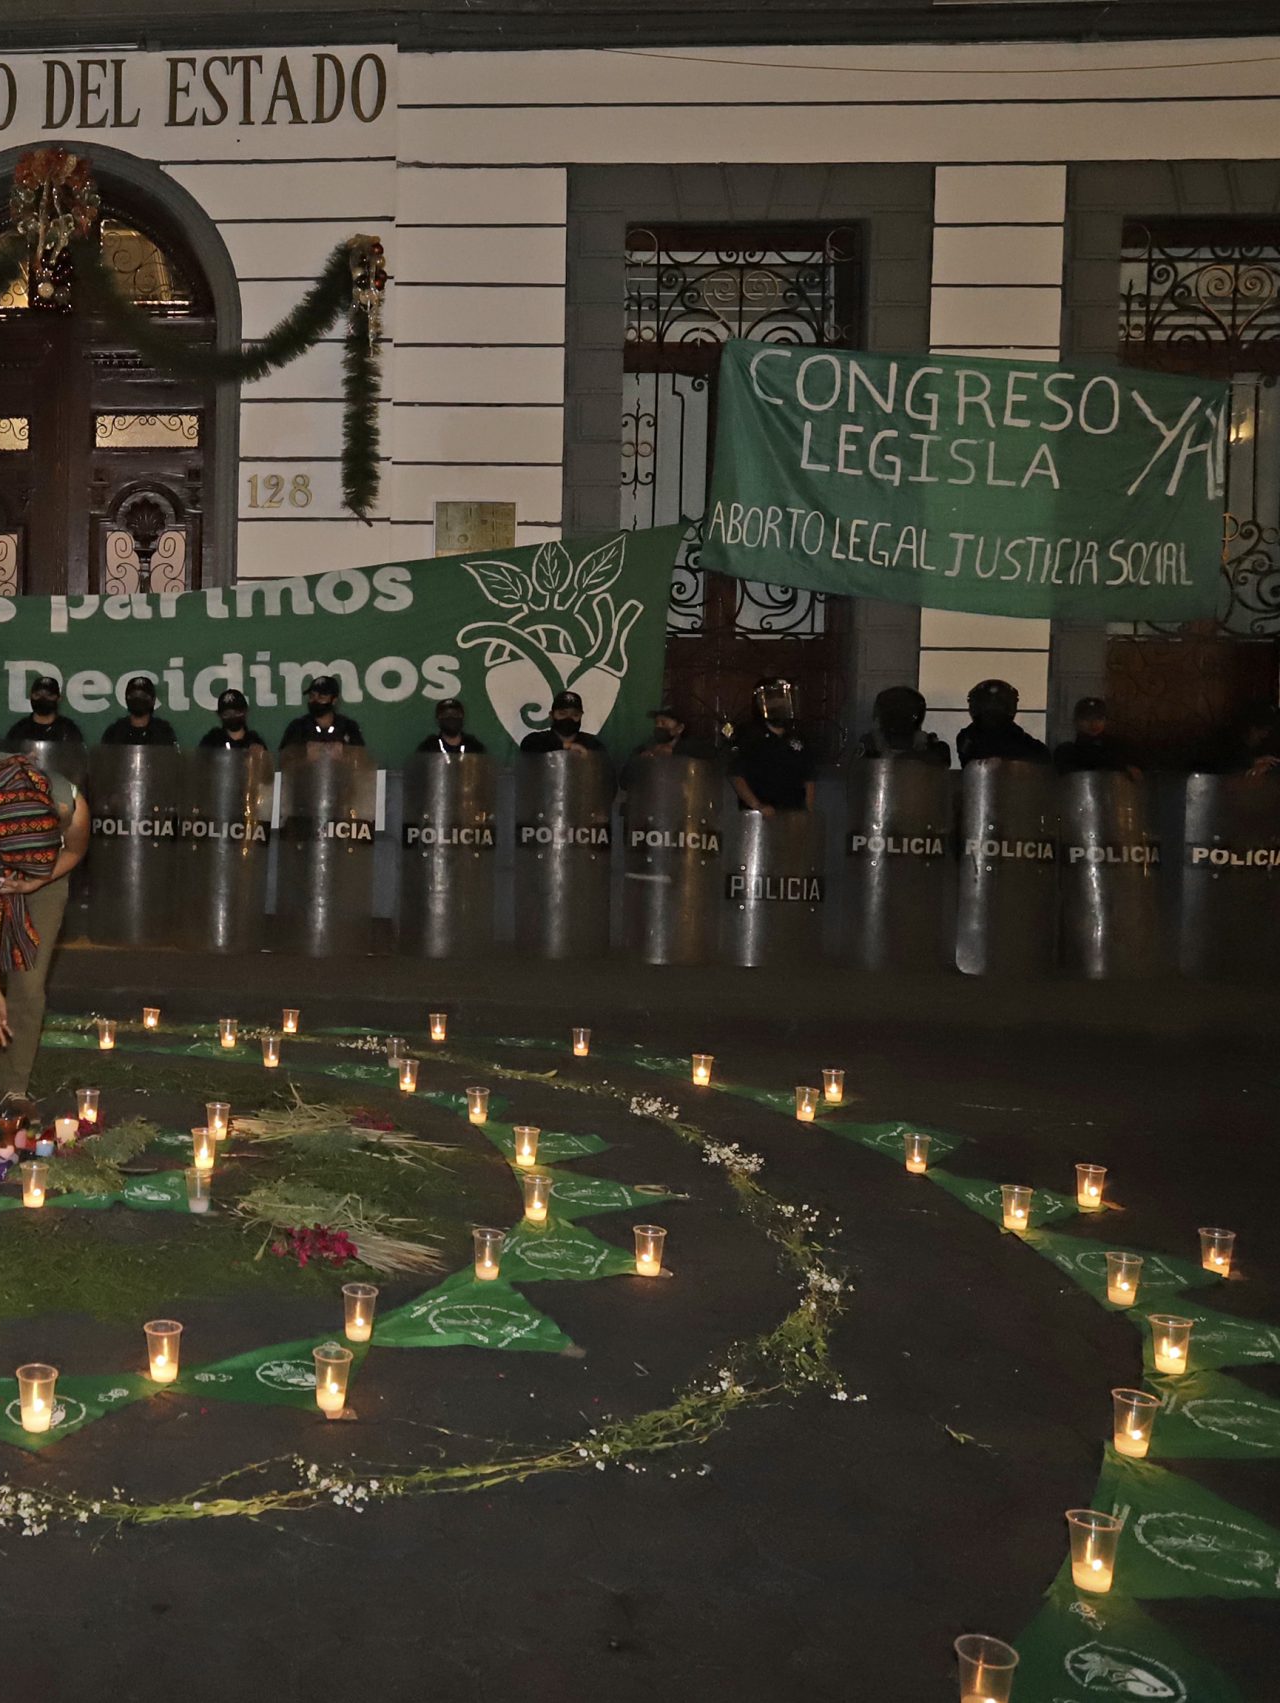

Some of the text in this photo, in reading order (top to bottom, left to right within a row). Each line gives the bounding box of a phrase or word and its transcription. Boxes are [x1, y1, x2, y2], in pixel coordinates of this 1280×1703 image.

[42, 57, 141, 130] DEL
[164, 52, 388, 128] ESTADO
[749, 348, 1121, 435] CONGRESO
[799, 420, 1061, 489] LEGISLA
[246, 473, 313, 509] 128
[708, 500, 1194, 586] ABORTO LEGAL JUSTICIA SOCIAL
[4, 651, 462, 714] Decidimos
[92, 817, 174, 837] POLICIA
[181, 820, 267, 842] POLICIA
[407, 827, 494, 846] POLICIA
[521, 826, 609, 846] POLICIA
[631, 829, 720, 851] POLICIA
[852, 835, 943, 856] POLICIA
[965, 838, 1054, 859] POLICIA
[1069, 845, 1160, 864] POLICIA
[730, 875, 820, 901] POLICIA
